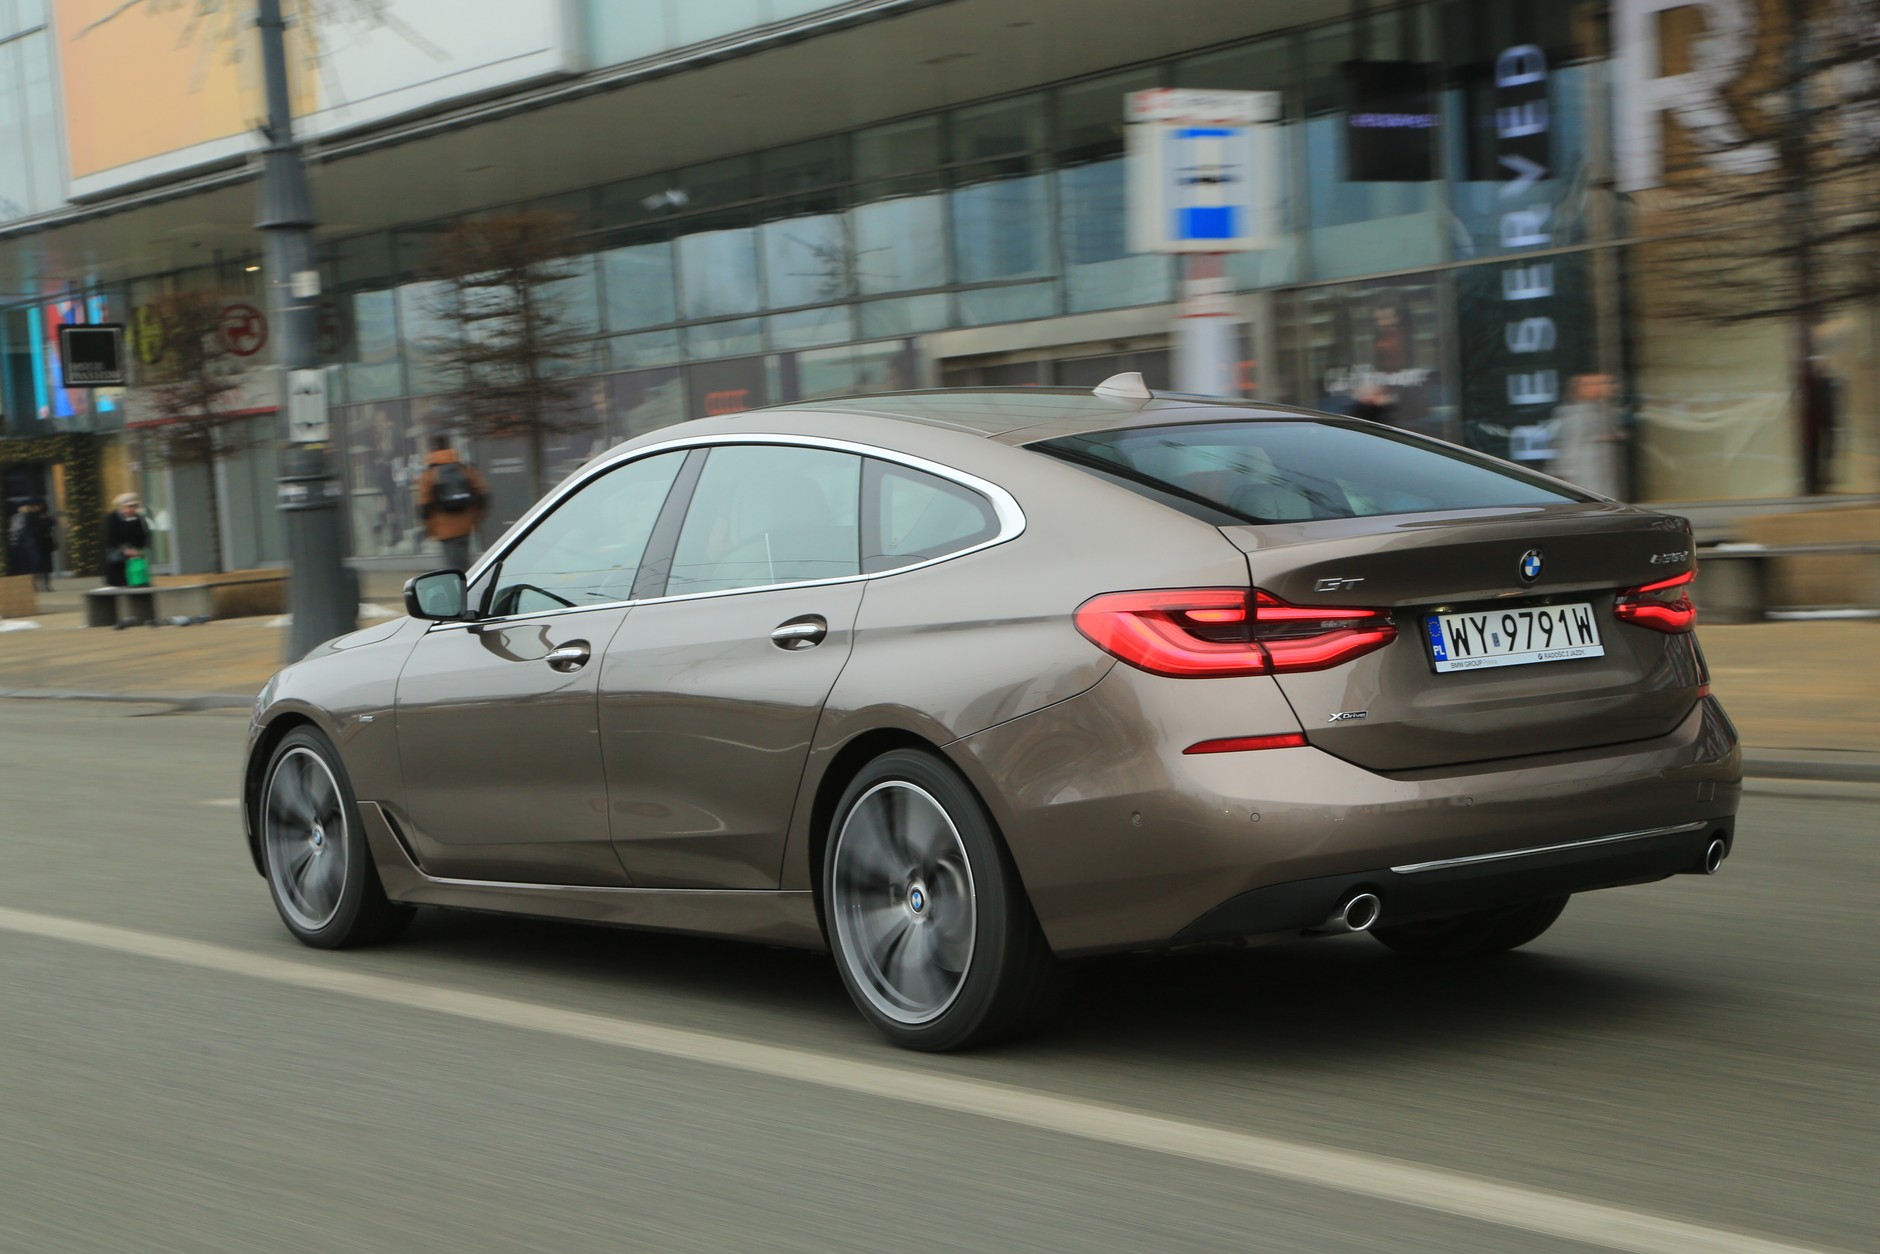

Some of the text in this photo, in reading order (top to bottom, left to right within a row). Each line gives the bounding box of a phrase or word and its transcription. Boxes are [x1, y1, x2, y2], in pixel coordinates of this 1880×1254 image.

[1495, 43, 1560, 461] RESERVED
[1313, 577, 1366, 593] GT
[1446, 607, 1594, 657] WY 9791W
[1432, 645, 1446, 656] PL
